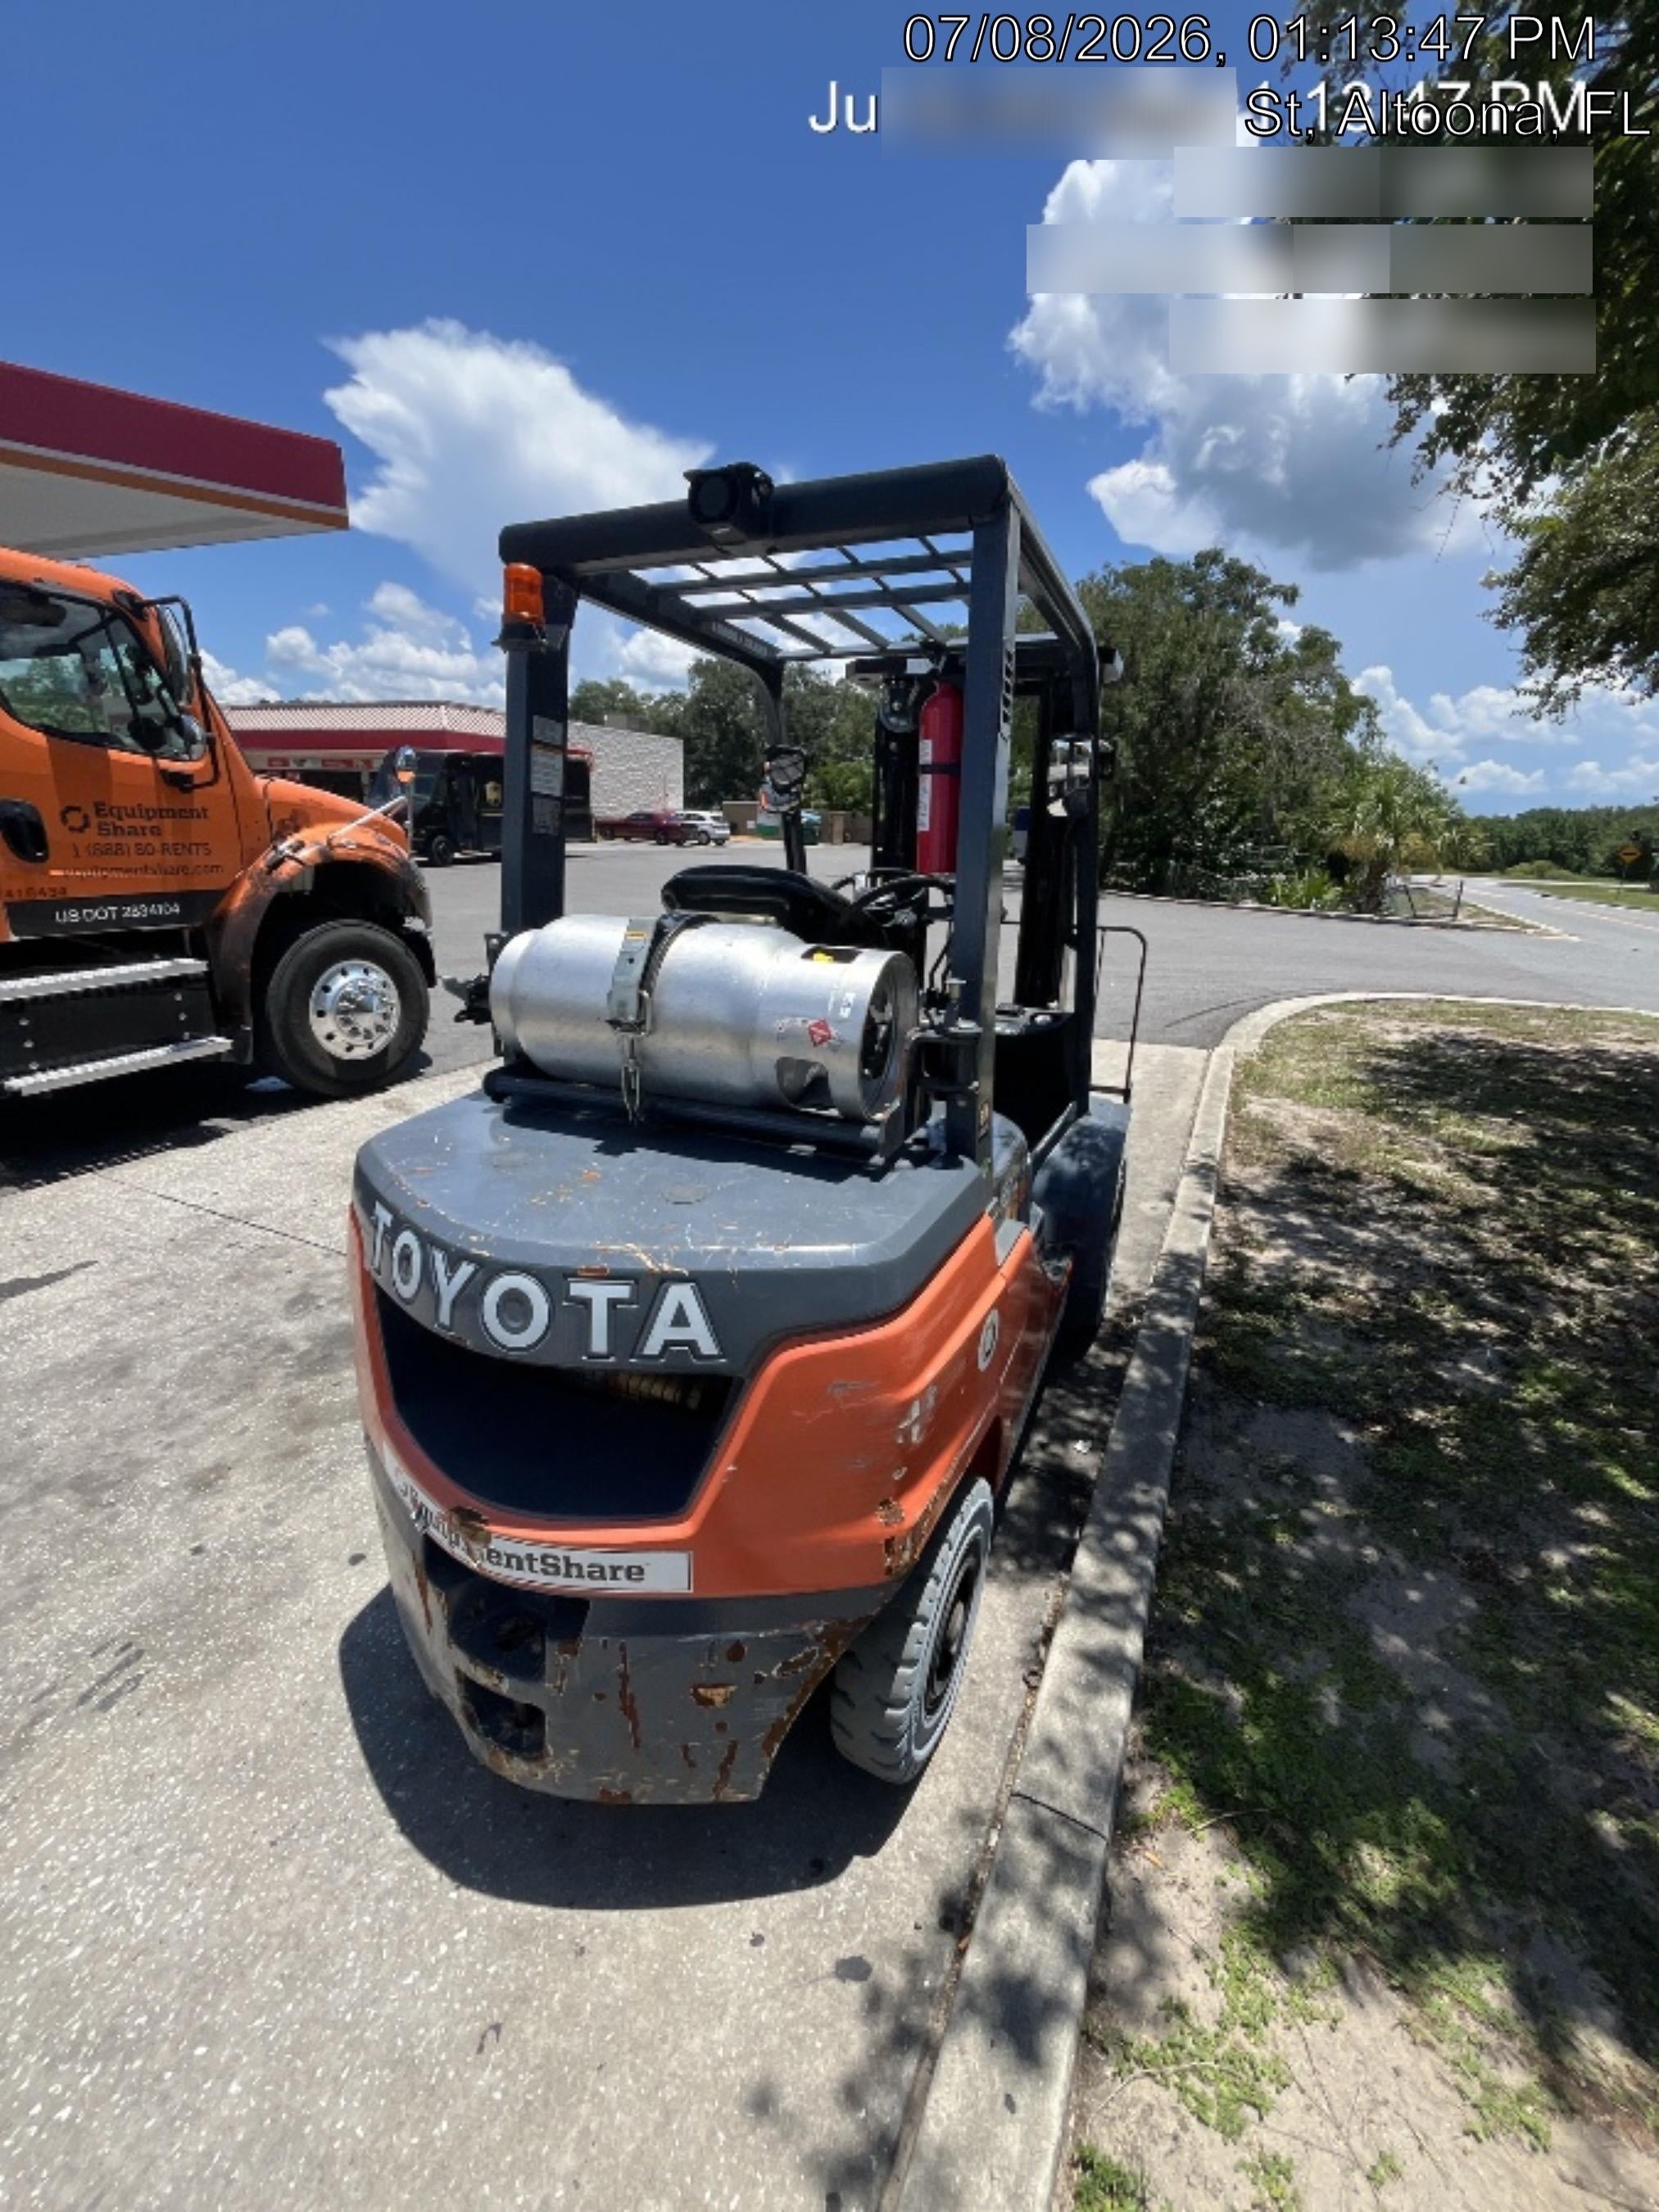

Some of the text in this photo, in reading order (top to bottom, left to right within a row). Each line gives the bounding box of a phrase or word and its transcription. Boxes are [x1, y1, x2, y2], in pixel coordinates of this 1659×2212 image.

[93, 801, 208, 820] Equipment
[97, 823, 162, 837] Share
[55, 909, 80, 923] US
[83, 906, 118, 921] DOT
[373, 1200, 726, 1361] TOYOTA
